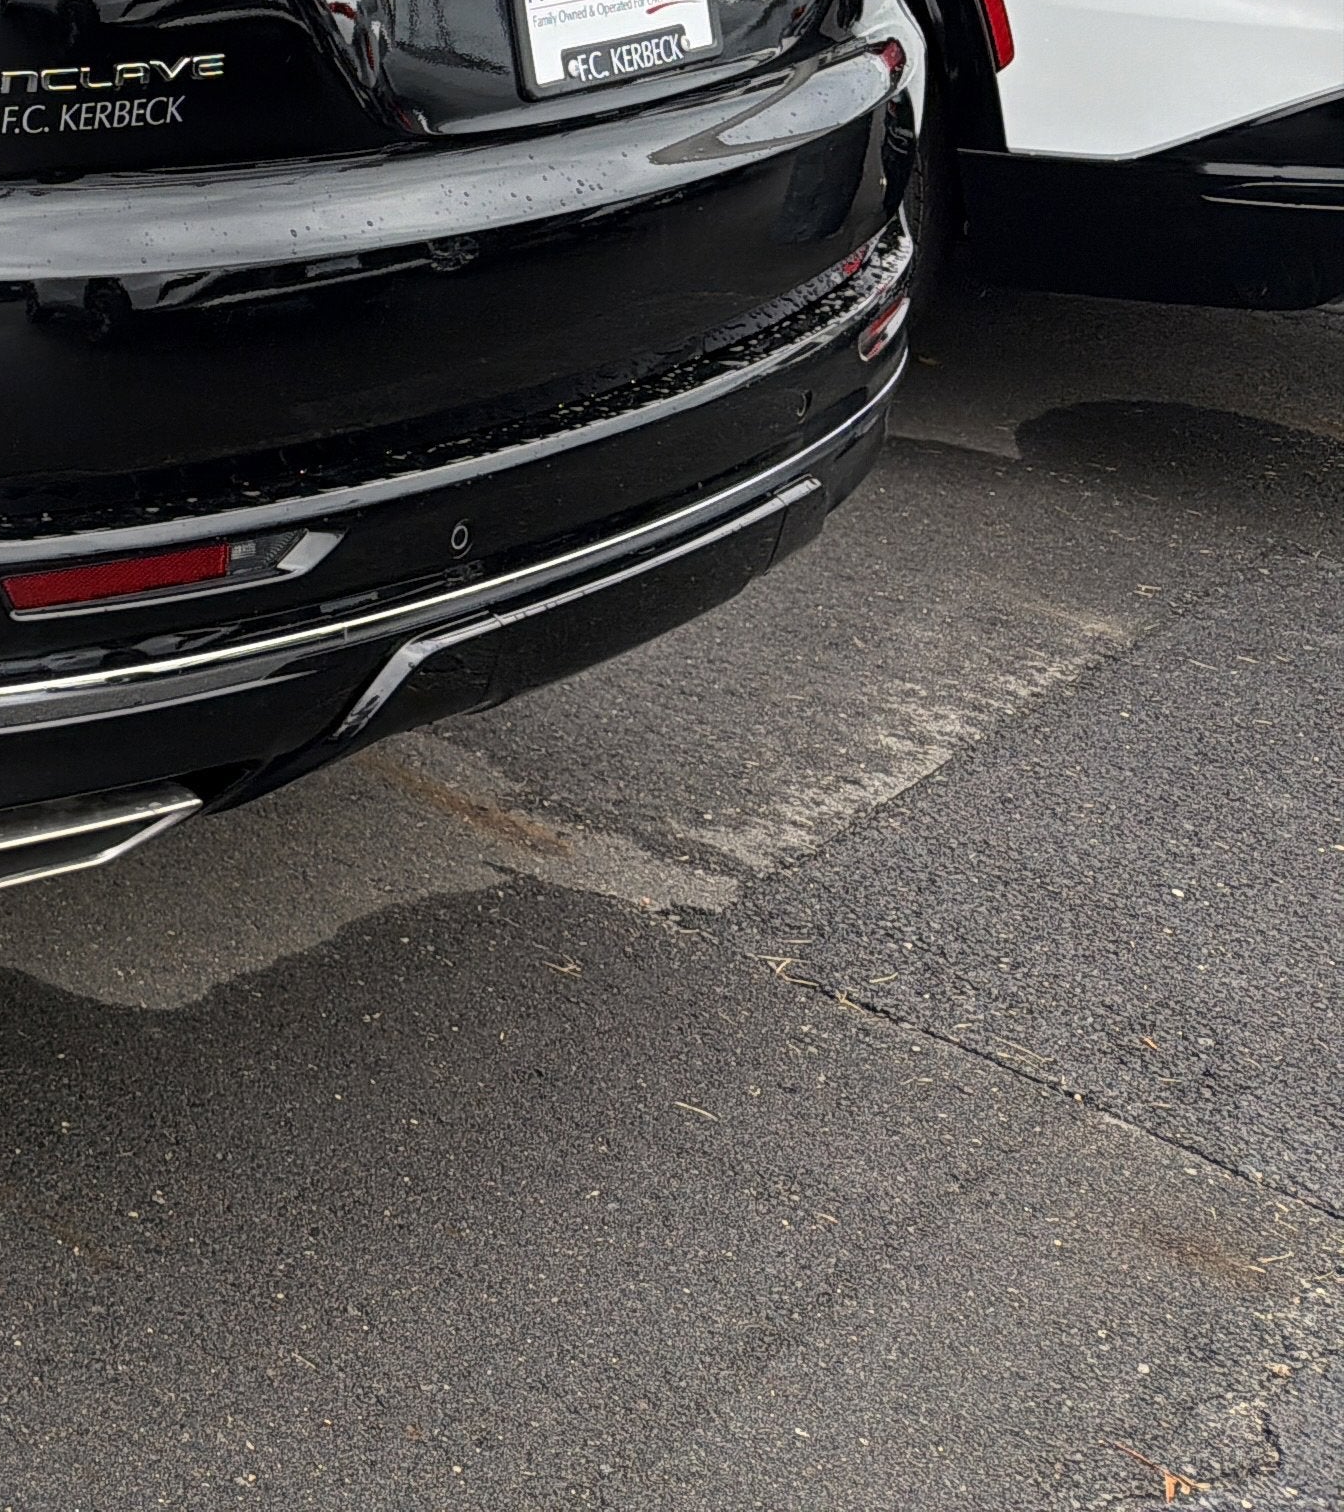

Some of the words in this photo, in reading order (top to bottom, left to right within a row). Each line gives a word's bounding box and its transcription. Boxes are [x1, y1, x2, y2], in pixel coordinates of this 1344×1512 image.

[533, 14, 558, 29] Family
[558, 9, 588, 24] Owned
[589, 6, 596, 17] &
[596, 0, 633, 17] Operated
[576, 51, 610, 81] F.C.
[611, 33, 683, 76] KERBECK
[1, 104, 50, 135] F.C.
[59, 94, 187, 132] KERBECK
